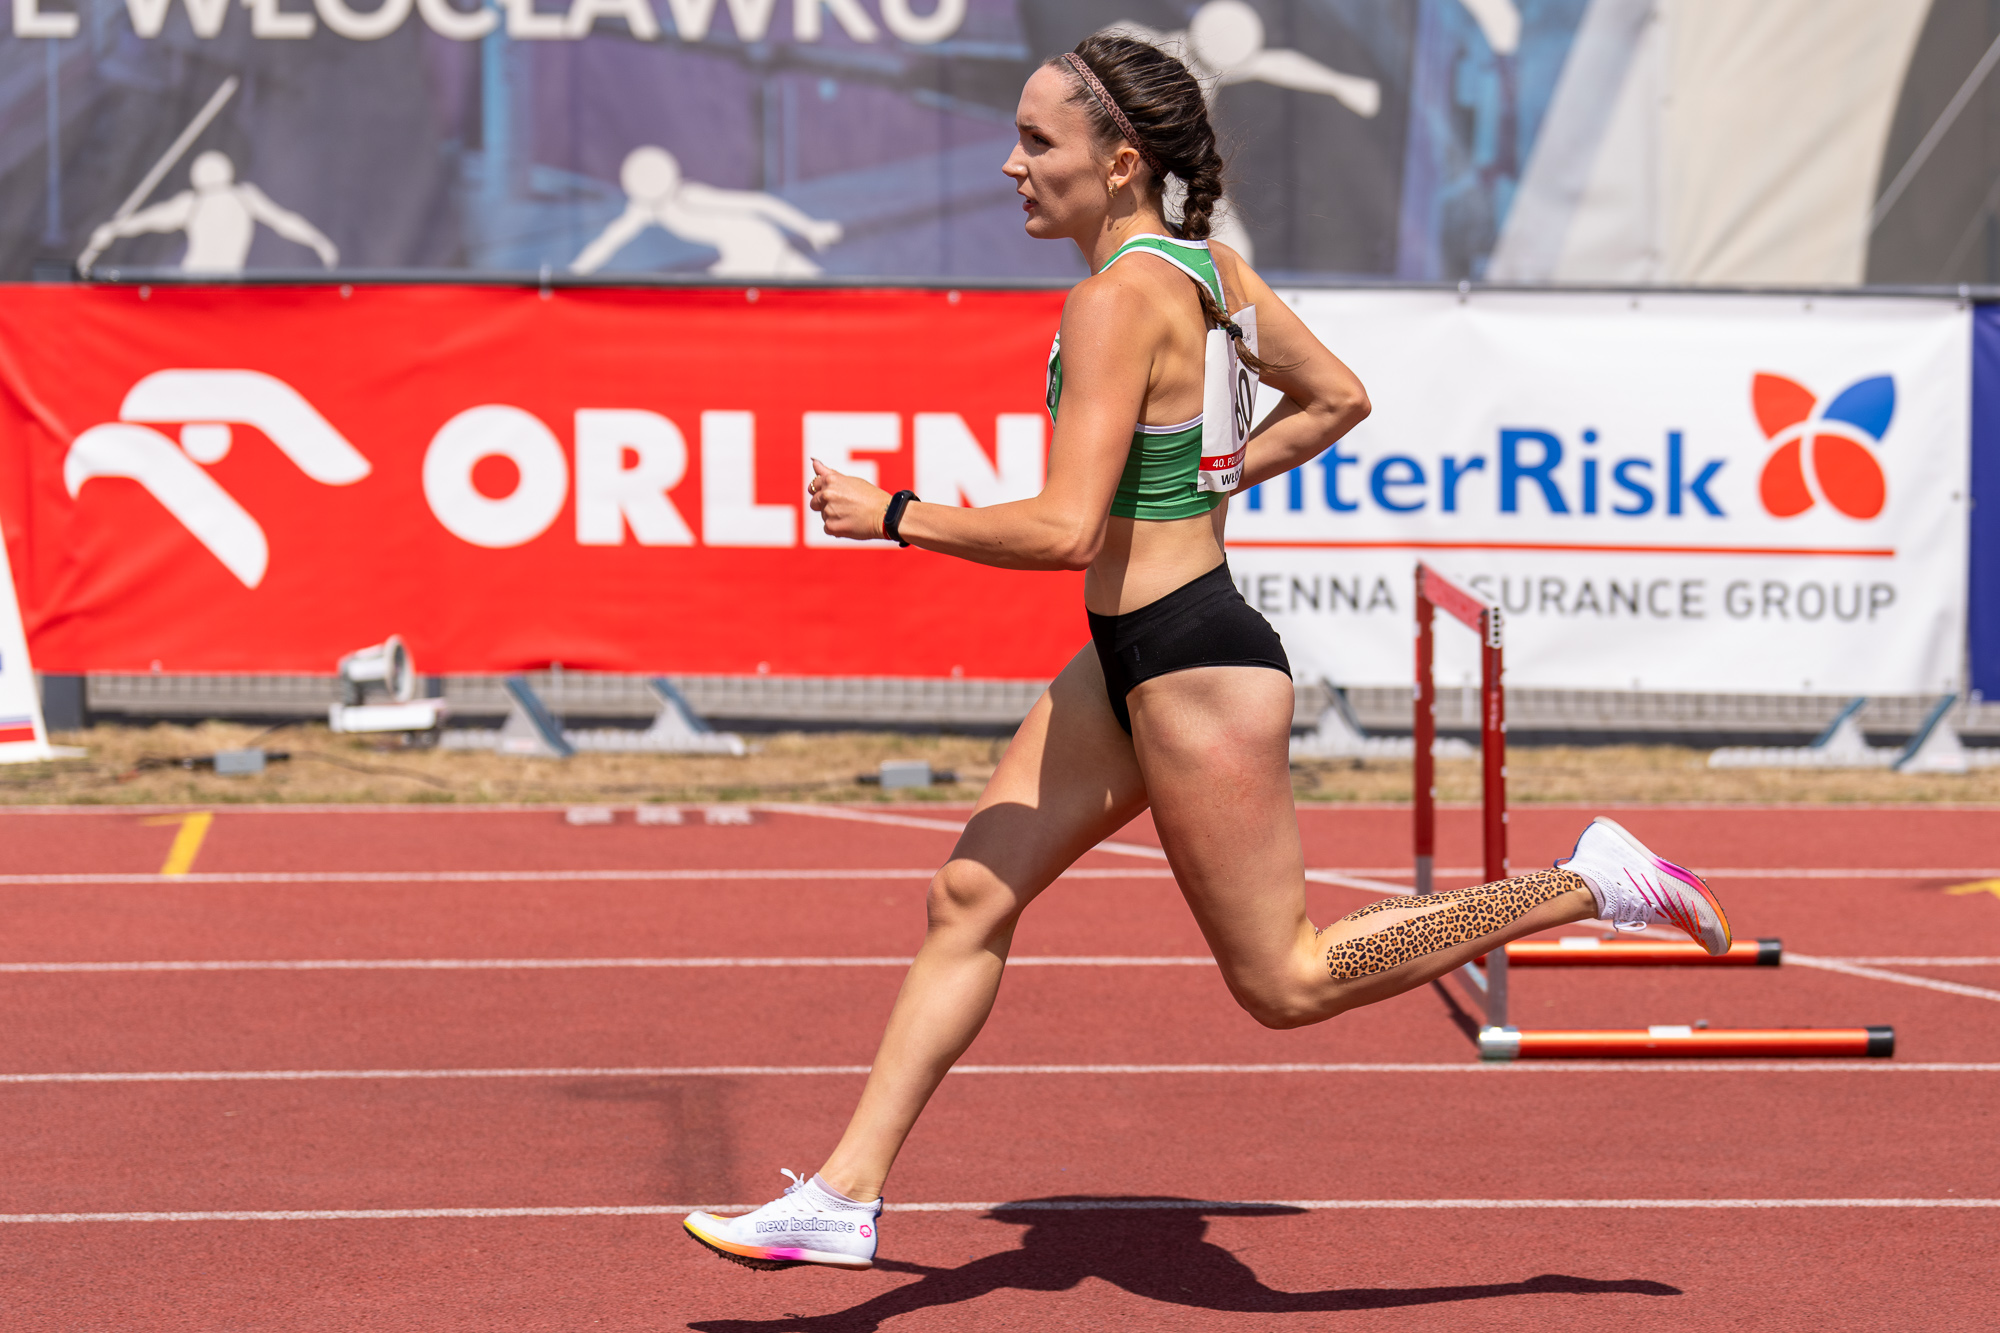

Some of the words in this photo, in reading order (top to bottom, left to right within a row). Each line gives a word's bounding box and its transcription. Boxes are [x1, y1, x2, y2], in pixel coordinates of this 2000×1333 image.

[422, 403, 1045, 549] ORLEN
[1212, 458, 1226, 468] 40.
[1236, 575, 1398, 614] IENNA
[1723, 579, 1897, 622] GROUP
[756, 1219, 788, 1234] new
[790, 1217, 856, 1234] balance
